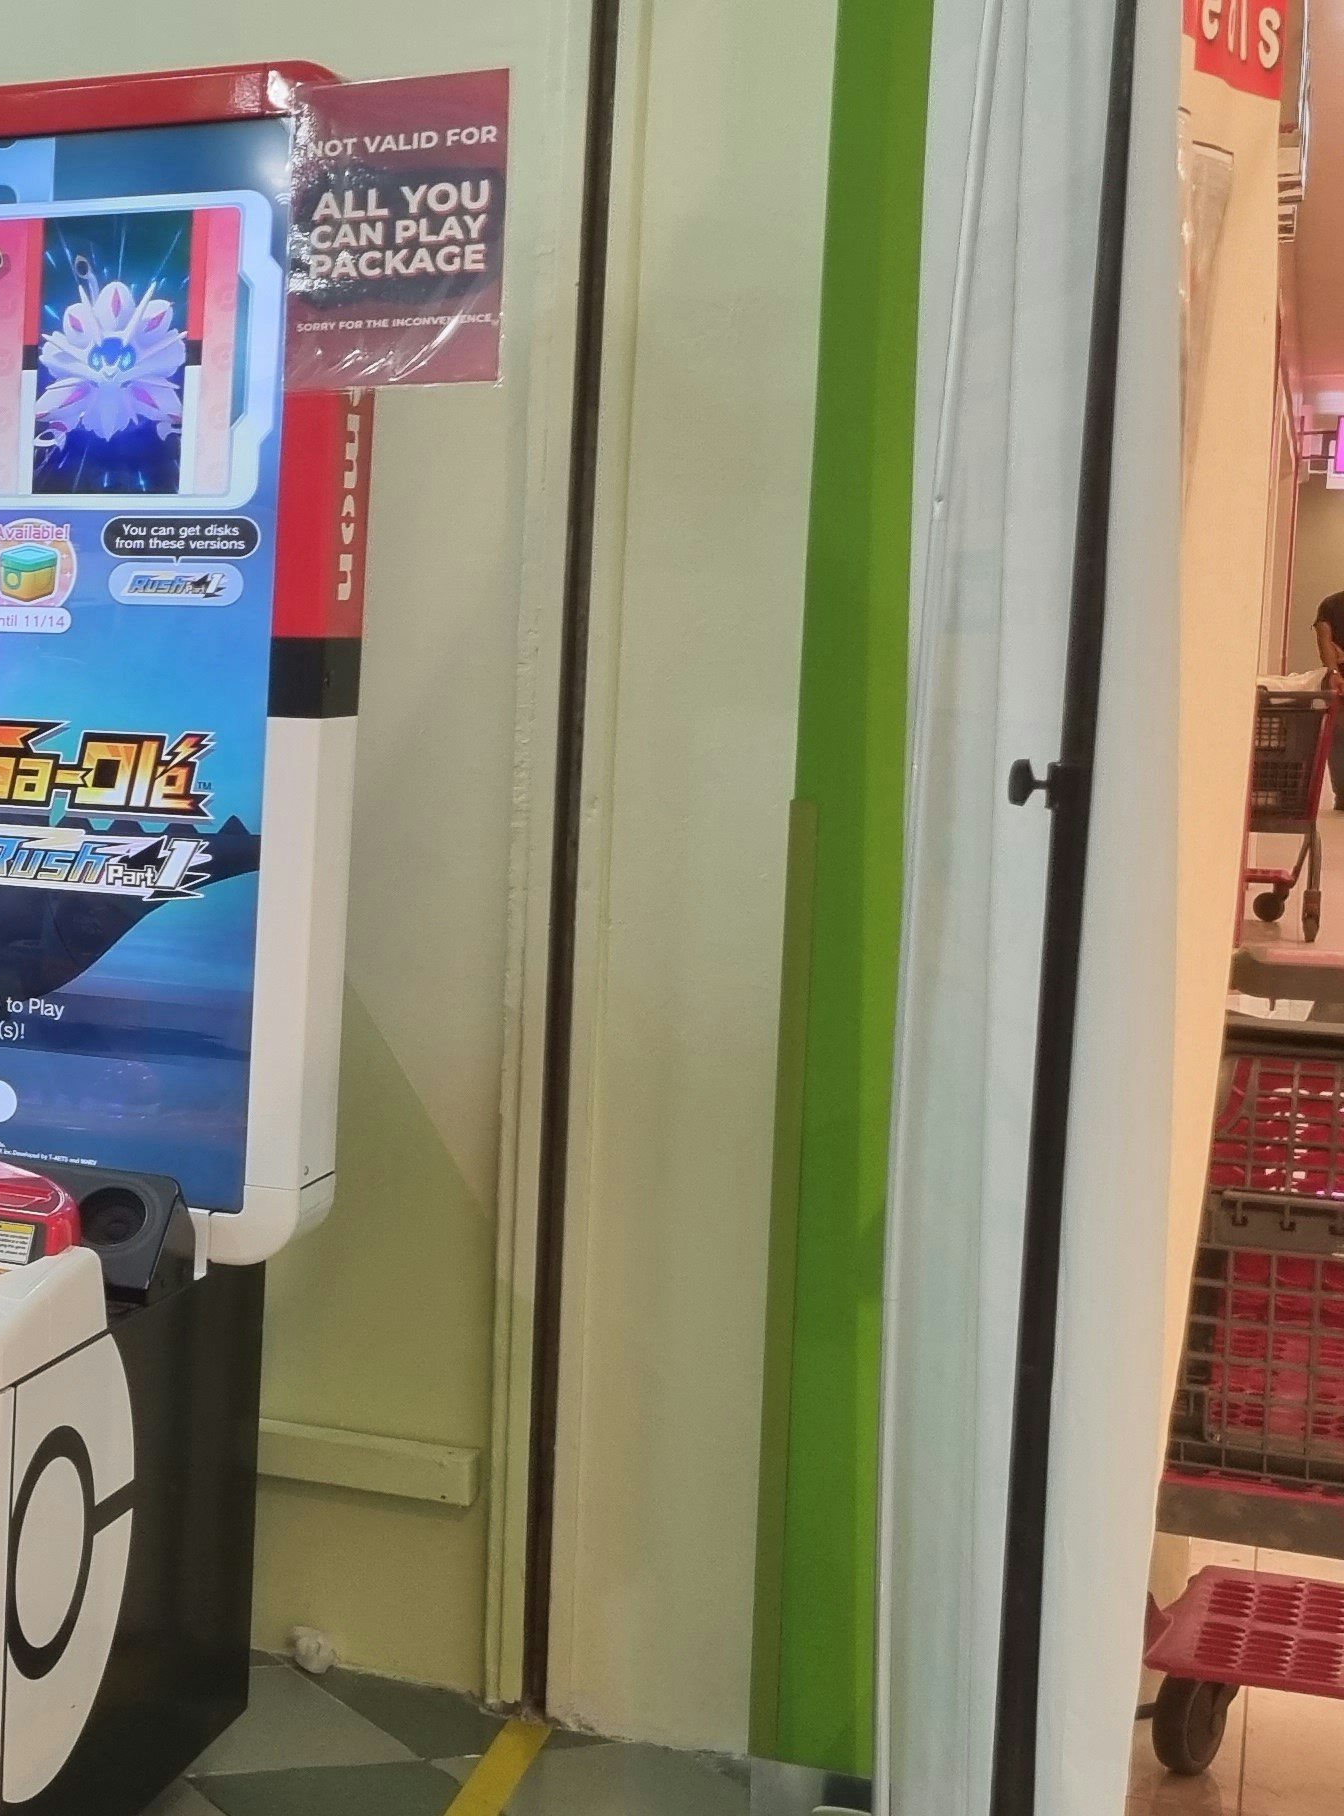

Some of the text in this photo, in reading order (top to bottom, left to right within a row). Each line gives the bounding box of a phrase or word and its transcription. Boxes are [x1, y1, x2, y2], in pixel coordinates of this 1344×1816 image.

[307, 125, 497, 159] NOT VALID FOR
[312, 179, 491, 222] ALL YOU
[312, 214, 487, 250] CAN PLAY
[310, 244, 487, 280] PACKAGE
[297, 319, 389, 333] SORRY FOR THE
[123, 523, 240, 538] You can get disks
[115, 538, 245, 550] from these versions
[128, 574, 185, 594] Rush
[24, 614, 65, 627] 11/14
[106, 864, 157, 887] Part
[154, 839, 198, 889] 1
[6, 997, 24, 1013] to
[28, 998, 65, 1021] Play
